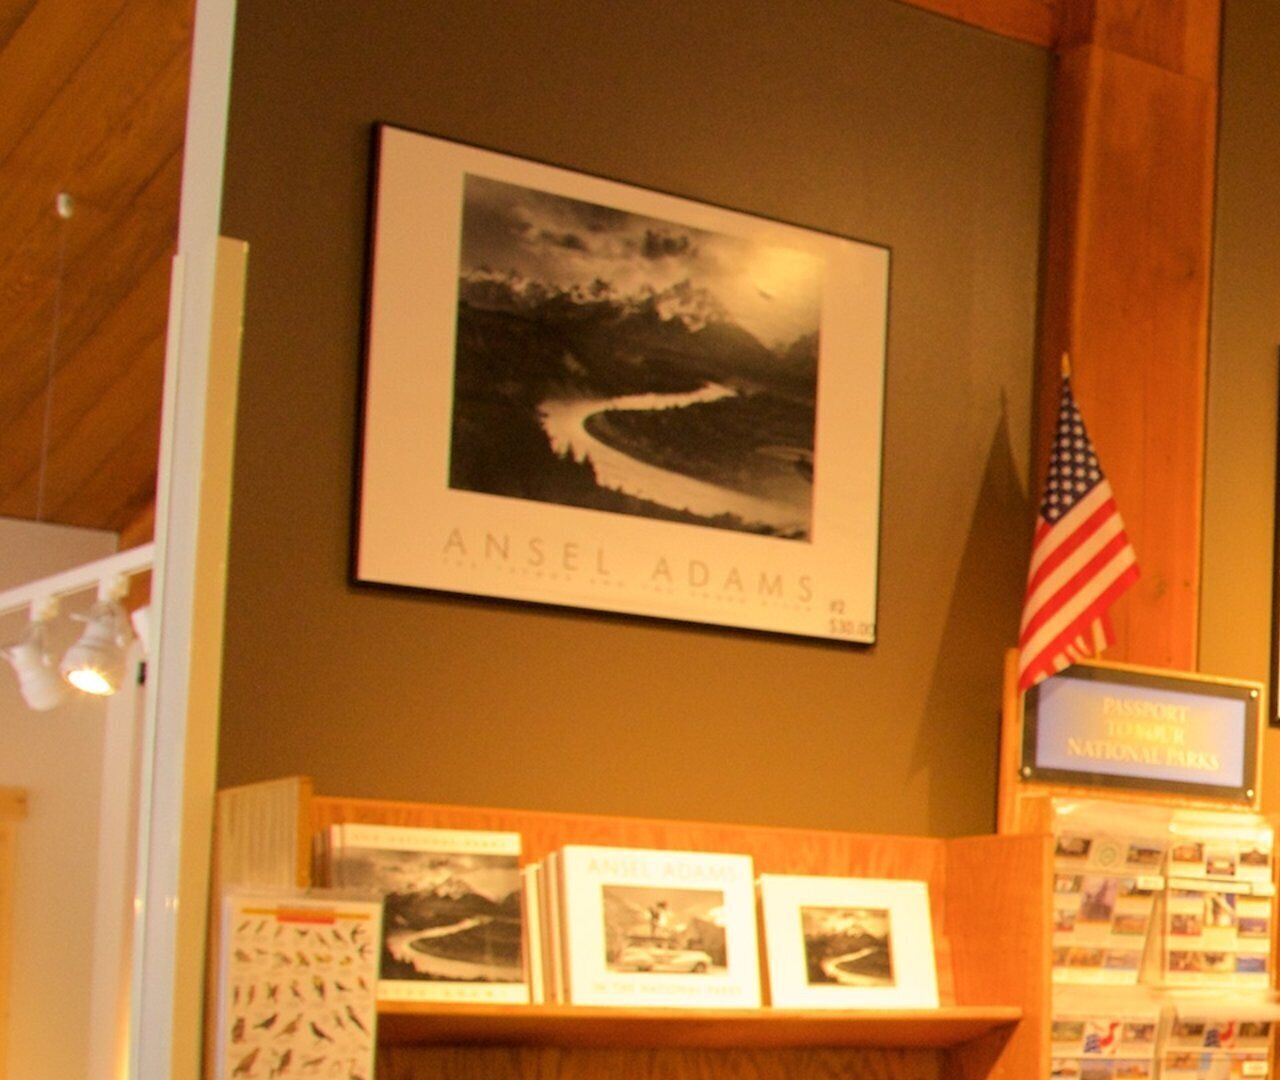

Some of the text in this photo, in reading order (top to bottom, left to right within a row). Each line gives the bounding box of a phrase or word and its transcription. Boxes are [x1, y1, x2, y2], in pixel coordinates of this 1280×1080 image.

[442, 527, 611, 577] ANSEL
[651, 556, 814, 604] ADAMS
[1103, 697, 1190, 723] PASSPORT
[1067, 737, 1221, 771] NATIONAL PARKS
[587, 856, 737, 884] ANSEL ADAMS
